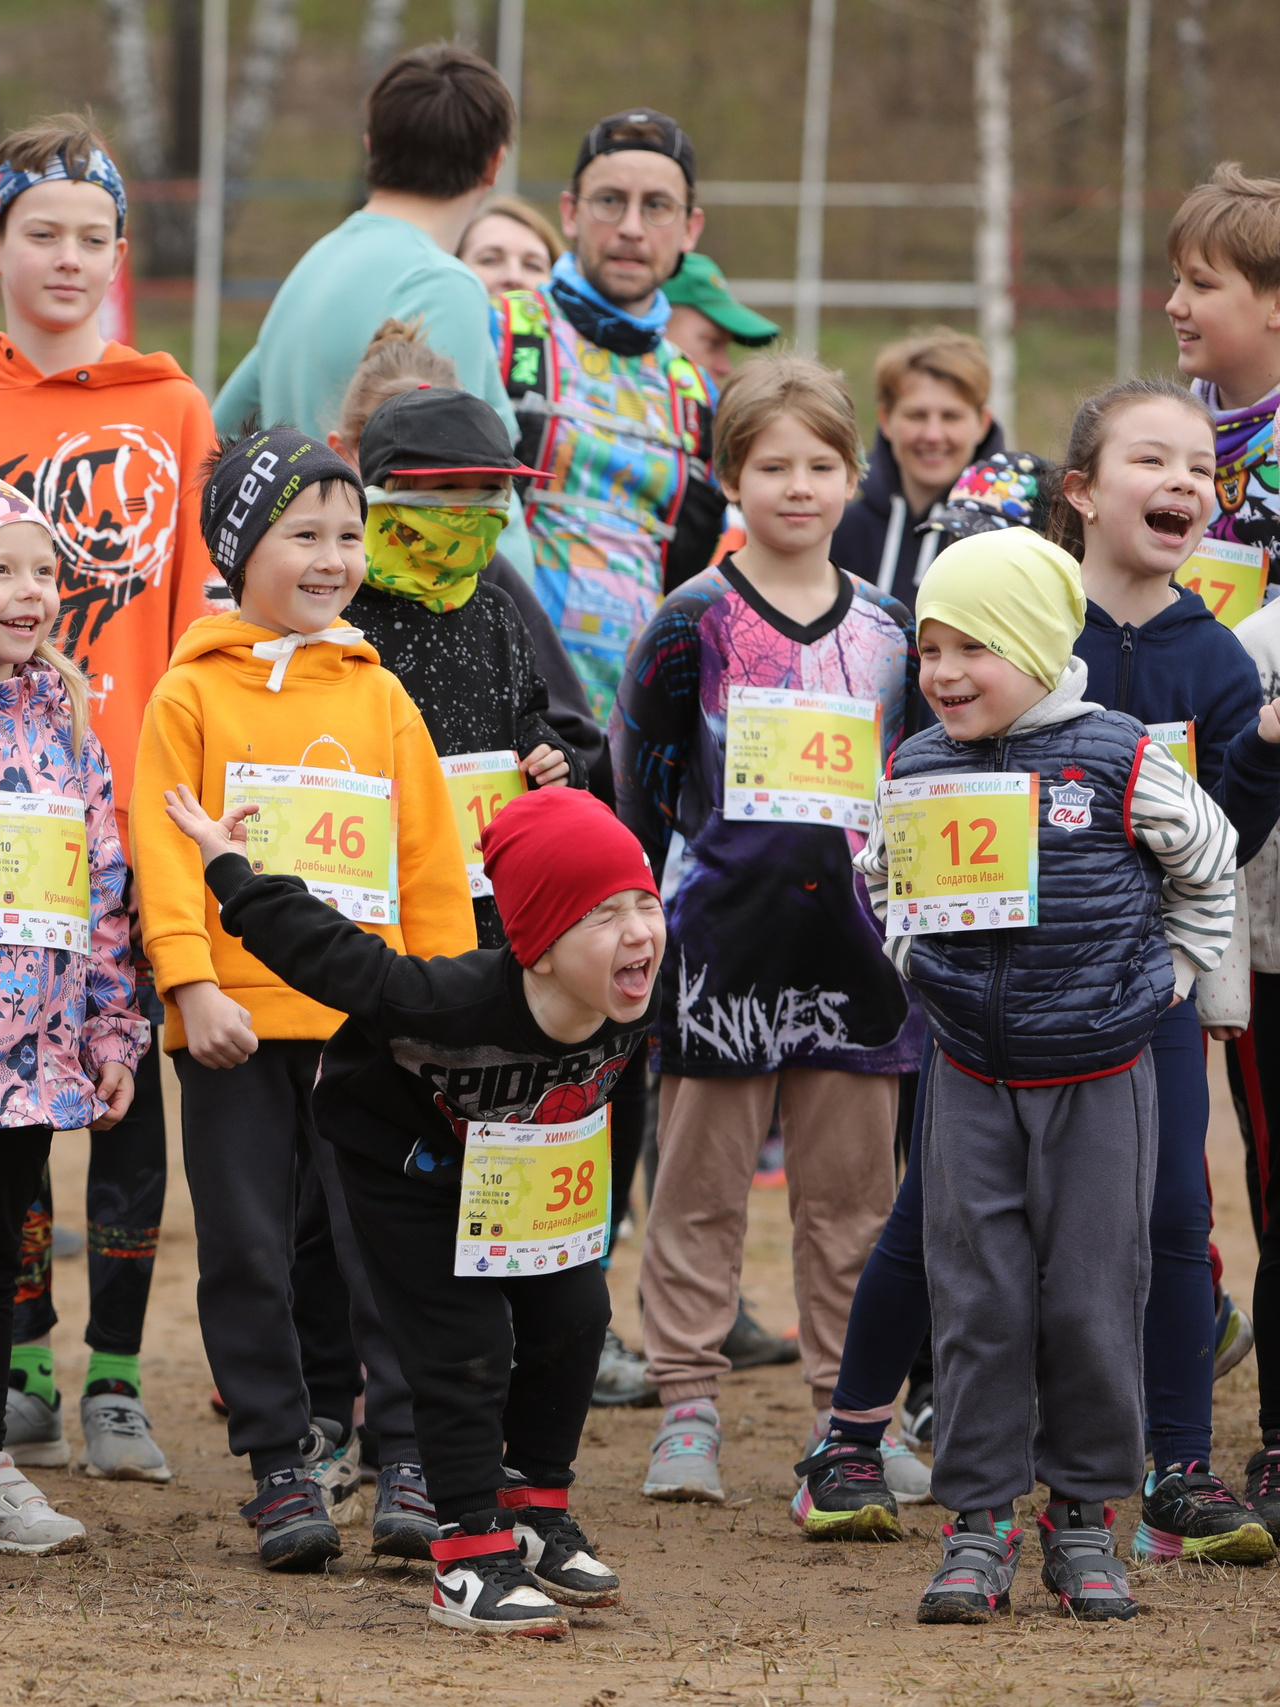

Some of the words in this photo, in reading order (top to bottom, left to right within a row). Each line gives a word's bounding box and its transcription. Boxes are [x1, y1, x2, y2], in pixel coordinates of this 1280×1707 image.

[253, 435, 270, 450] cep
[295, 442, 312, 457] cep
[226, 450, 279, 529] cep
[276, 474, 301, 509] cep
[1244, 553, 1260, 565] ЛЕС
[793, 697, 856, 713] ХИМКИНСКИЙ
[857, 705, 871, 717] ЛЕС
[742, 730, 761, 741] 1,10
[1167, 730, 1183, 742] ЛЕС
[801, 731, 854, 773] 43
[450, 757, 501, 774] ХИМКИНСКИЙ
[501, 757, 514, 769] ЛЕС
[299, 774, 369, 792] ХИМКИНСКИЙ
[370, 784, 388, 796] ЛЕС
[827, 776, 865, 791] Виктория
[928, 777, 1001, 796] ХИМКИНСКИЙ
[1004, 780, 1024, 792] ЛЕС
[1059, 792, 1085, 804] KING
[913, 811, 927, 820] 2024
[1053, 808, 1086, 824] Club
[25, 826, 42, 834] 2024
[305, 811, 365, 859] 46
[893, 831, 906, 843] 1,10
[940, 817, 999, 866] 12
[294, 858, 336, 873] Довбыш
[337, 863, 373, 879] Максим
[936, 873, 978, 887] Солдатов
[979, 871, 1004, 883] Иван
[677, 943, 850, 1066] KNIVES
[518, 1157, 536, 1165] 2024
[481, 1173, 502, 1186] 1,10
[545, 1160, 595, 1212] 38
[532, 1216, 571, 1231] Богданов
[571, 1208, 597, 1226] Даниил
